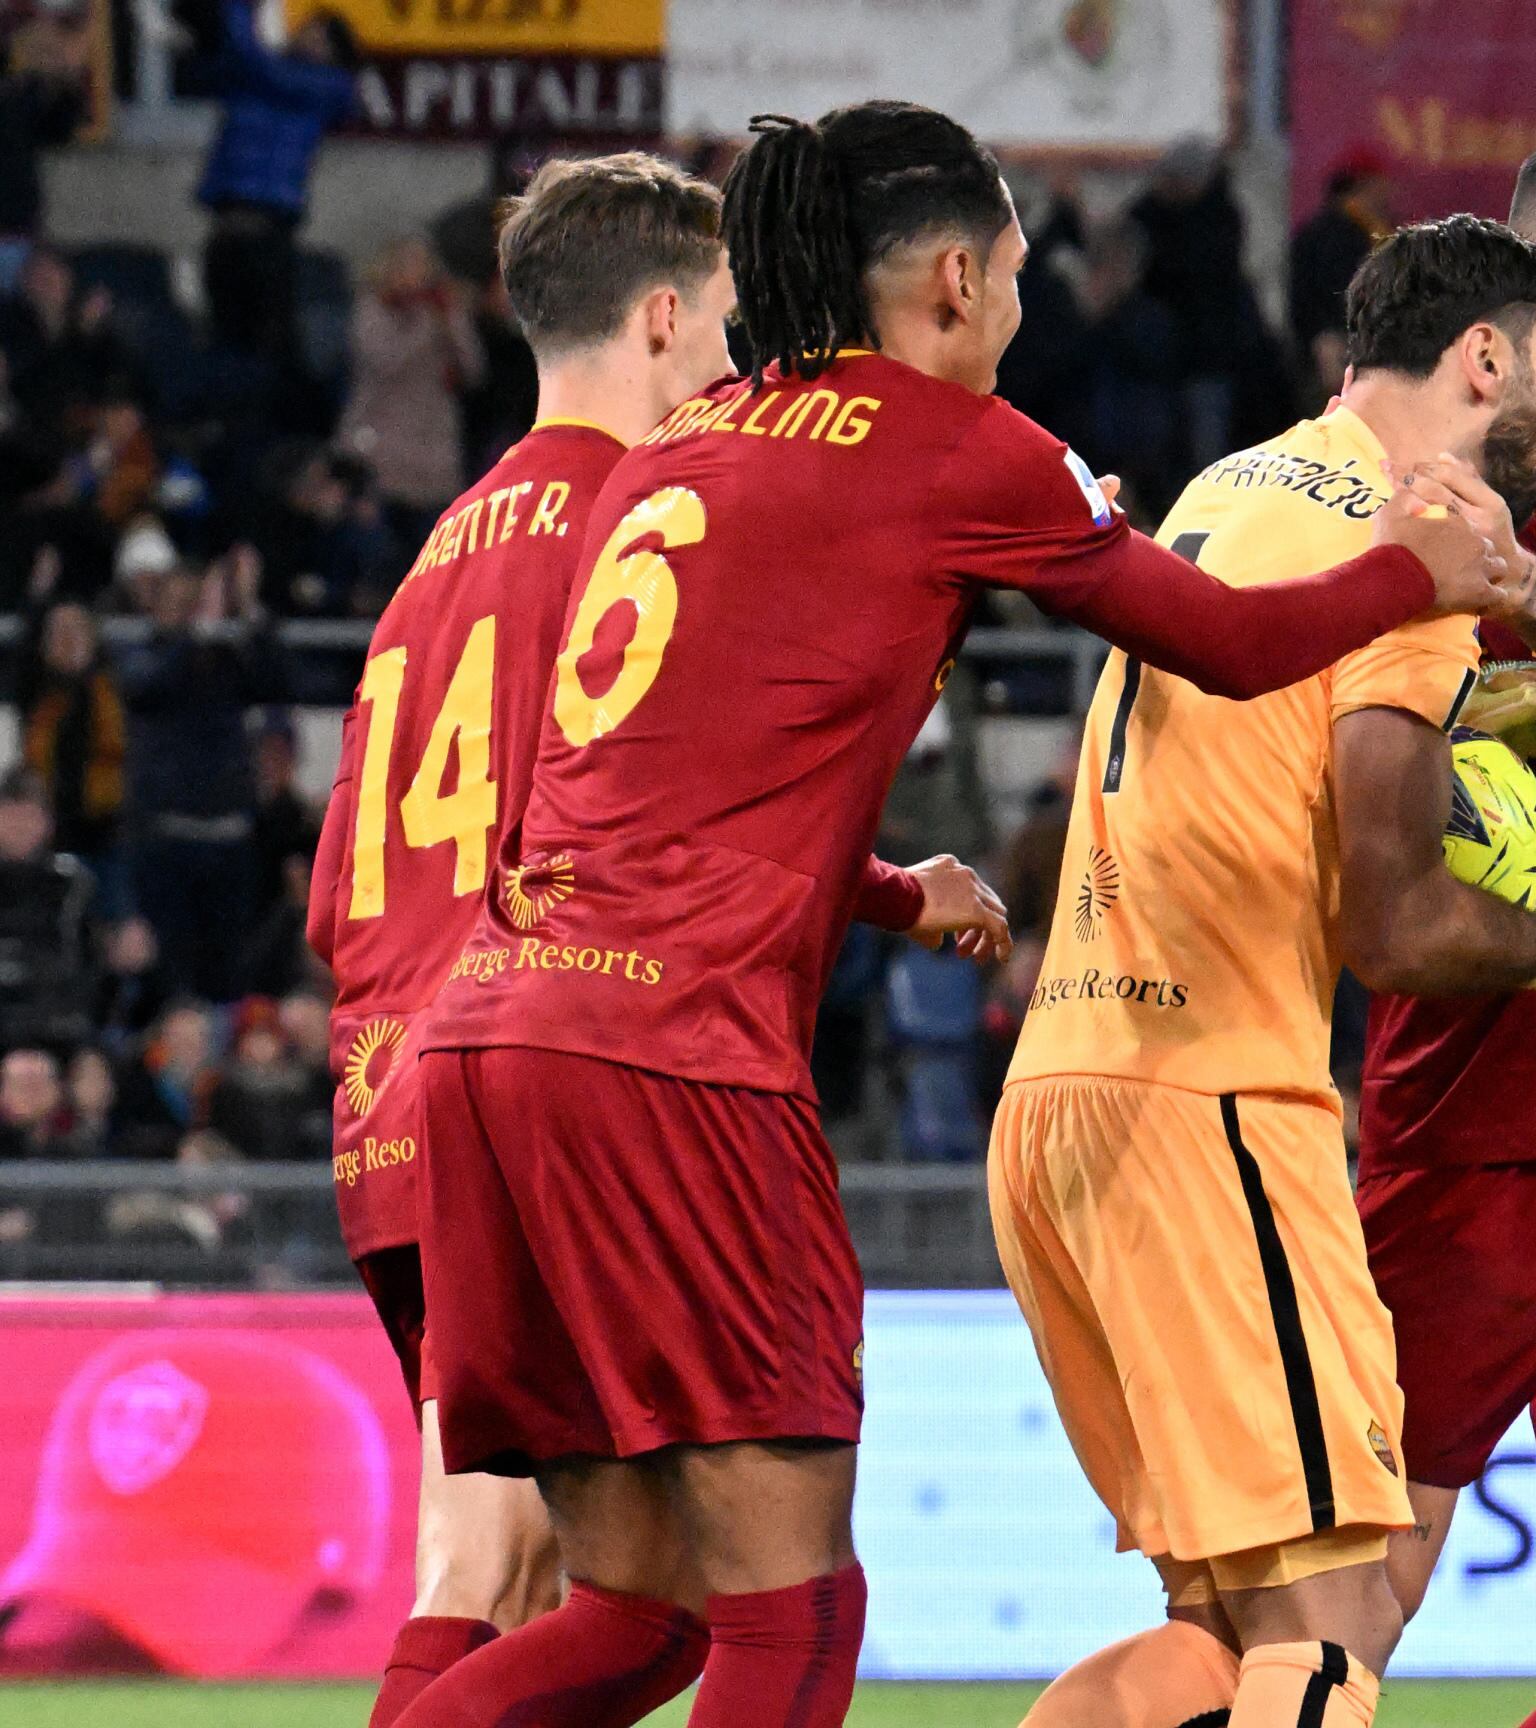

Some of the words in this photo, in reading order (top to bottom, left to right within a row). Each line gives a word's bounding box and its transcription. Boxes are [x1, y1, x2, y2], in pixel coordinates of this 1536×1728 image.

[355, 62, 662, 133] APITALE
[554, 486, 707, 747] 6
[348, 614, 498, 920] 14
[514, 937, 665, 986] Resorts
[363, 1136, 416, 1172] Reso
